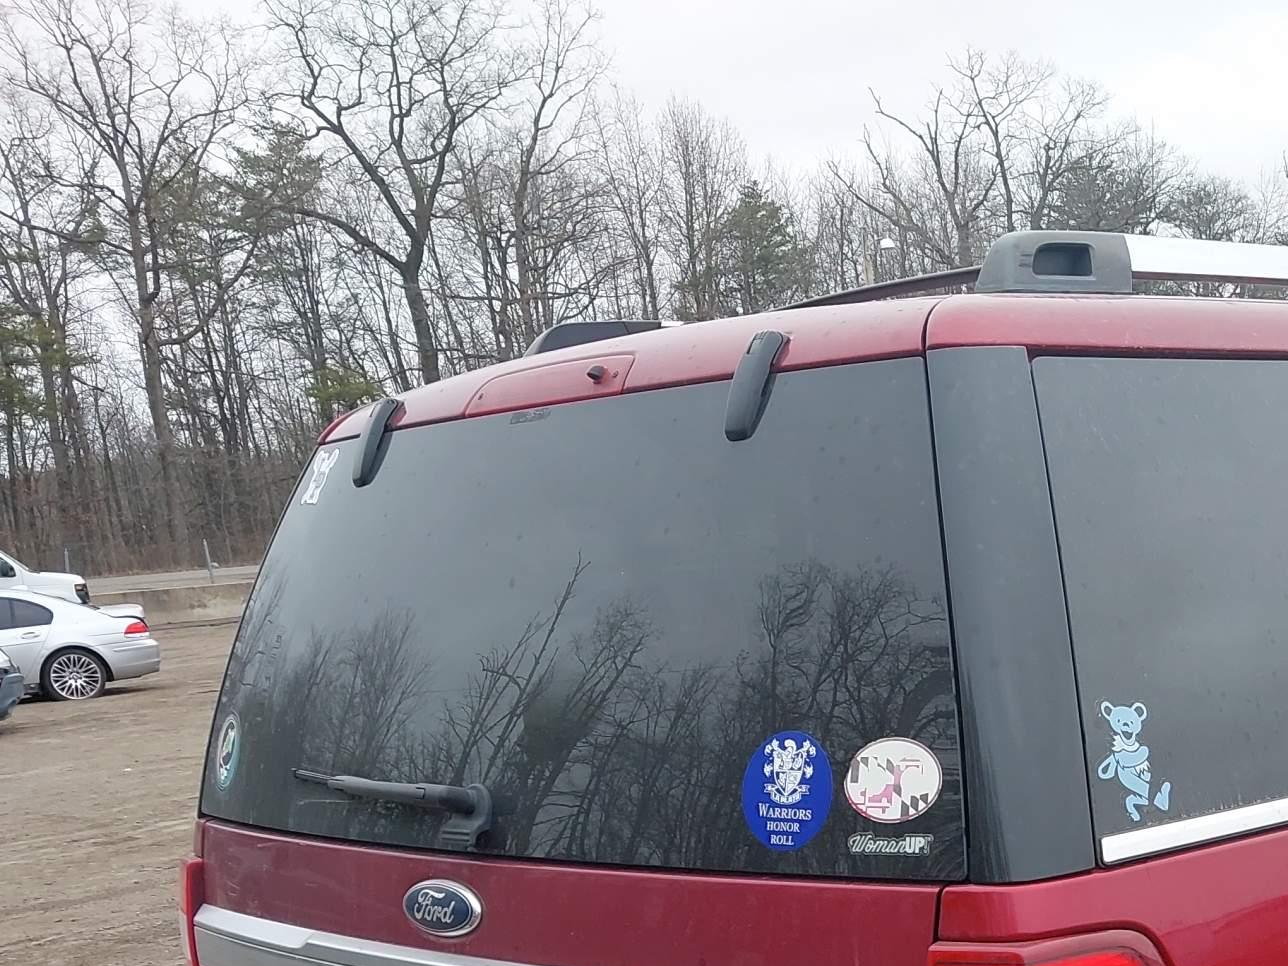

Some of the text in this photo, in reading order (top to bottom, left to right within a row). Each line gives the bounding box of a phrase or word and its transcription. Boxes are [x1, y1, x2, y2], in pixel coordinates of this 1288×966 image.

[767, 821, 800, 833] HONOR
[770, 834, 795, 846] ROLL
[413, 888, 457, 924] Ford
